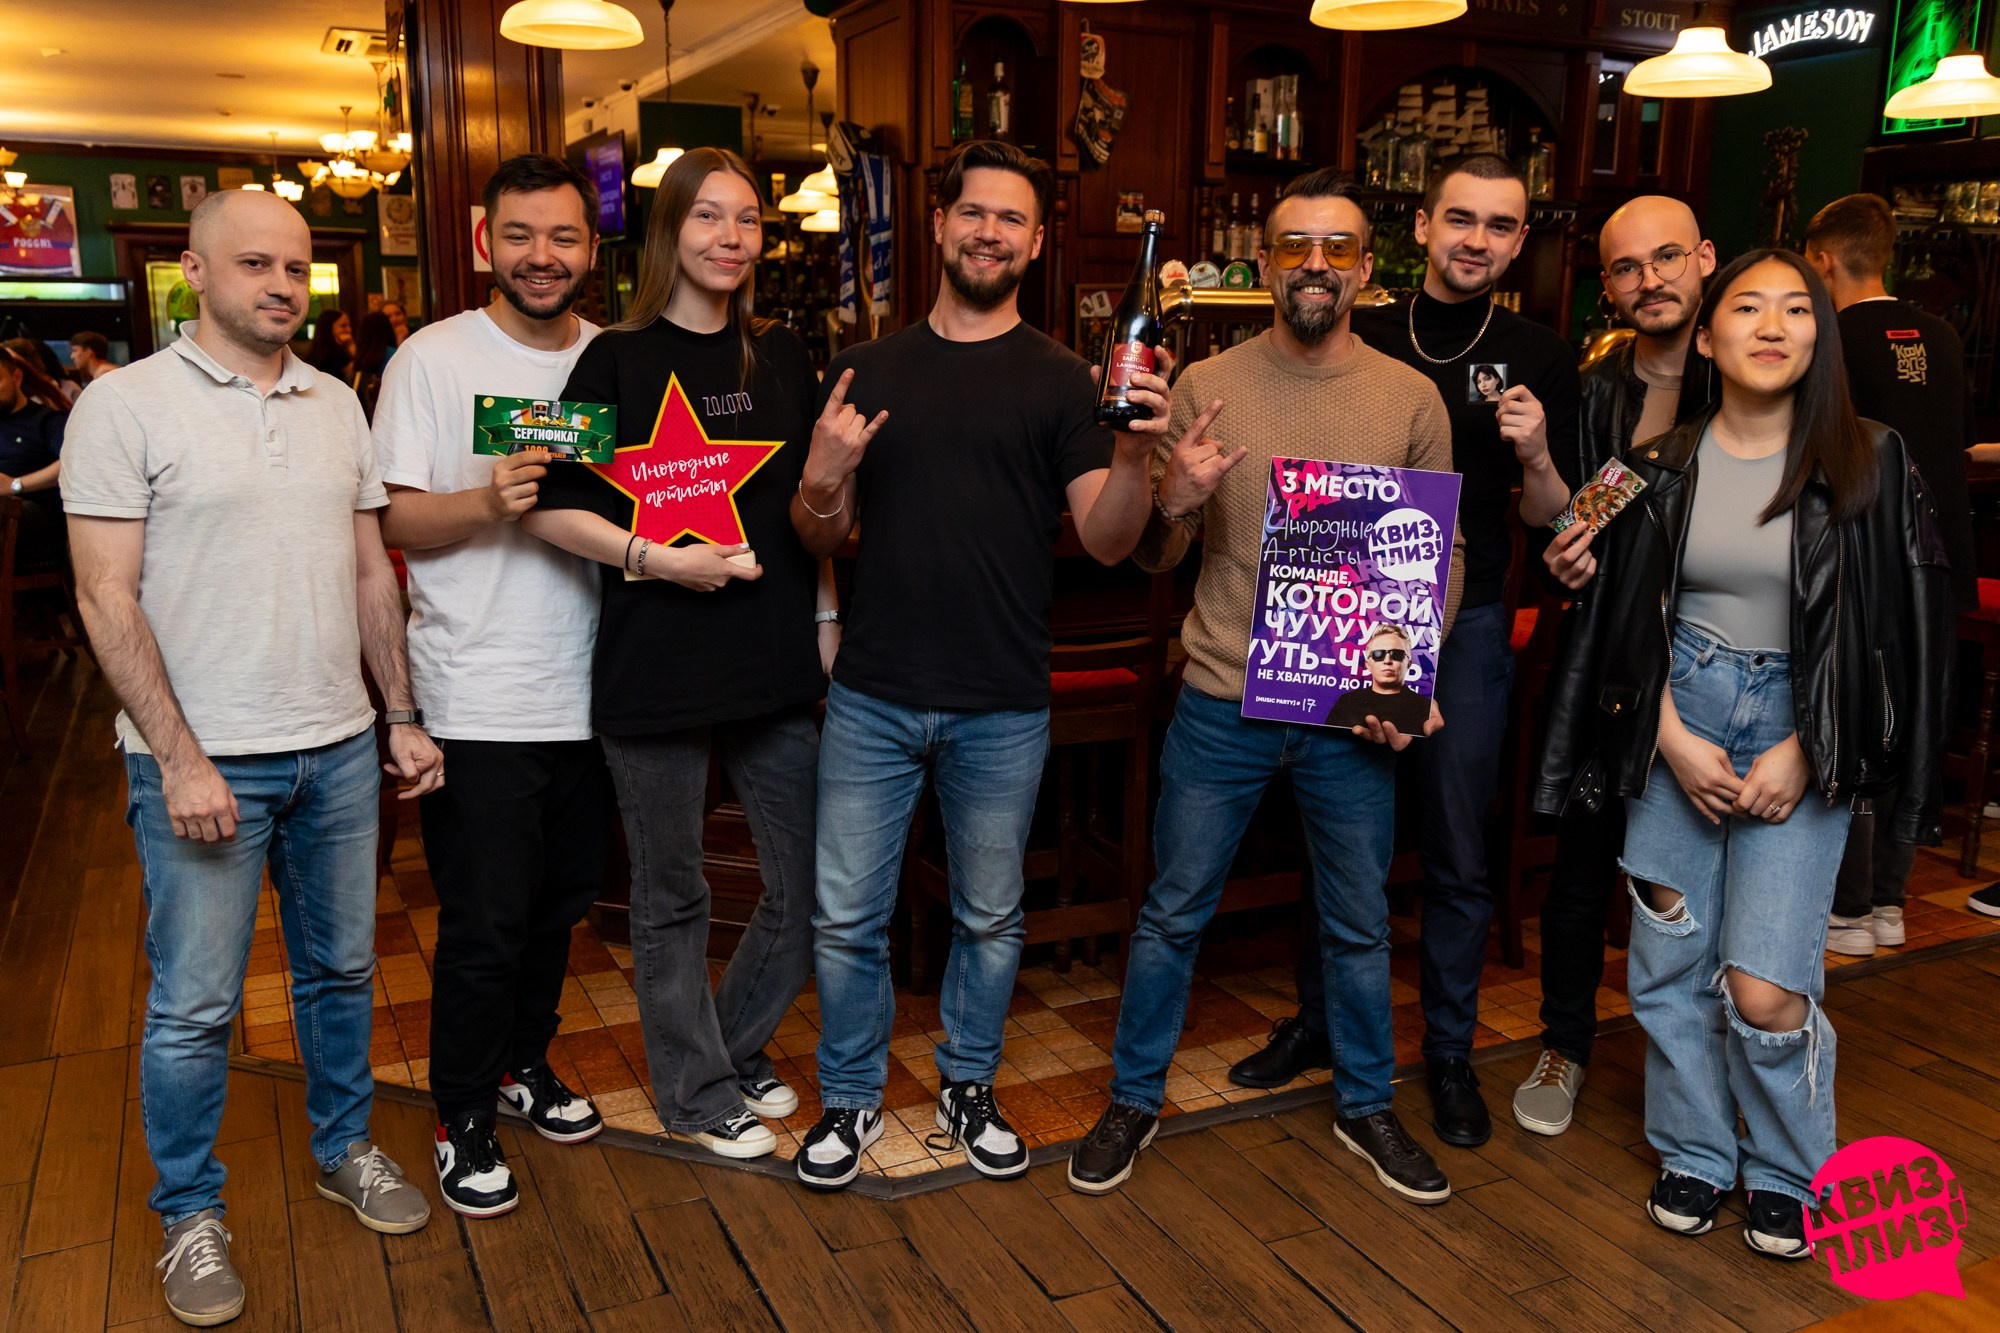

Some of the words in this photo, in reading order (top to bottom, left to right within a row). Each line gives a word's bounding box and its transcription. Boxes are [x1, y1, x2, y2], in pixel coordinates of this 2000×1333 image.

[1620, 8, 1681, 32] STOUT
[1747, 8, 1875, 58] JAMESON
[1116, 362, 1151, 373] LAMBRUSCO
[702, 391, 753, 416] ZOLOTO
[514, 427, 580, 444] СЕРТИФИКАТ
[631, 452, 731, 481] Инородные
[645, 479, 727, 508] артисты
[1281, 470, 1298, 493] 3
[1304, 473, 1401, 503] МЕСТО
[1370, 519, 1441, 547] КВИЗ,
[1371, 540, 1442, 567] ПЛИЗ!
[1269, 564, 1352, 587] КОМАНДЕ,
[1266, 580, 1433, 624] КОТОРОЙ
[1257, 668, 1274, 680] НЕ
[1276, 670, 1337, 687] ХВАТИЛО
[1339, 677, 1361, 690] ДО
[1302, 698, 1317, 713] 17
